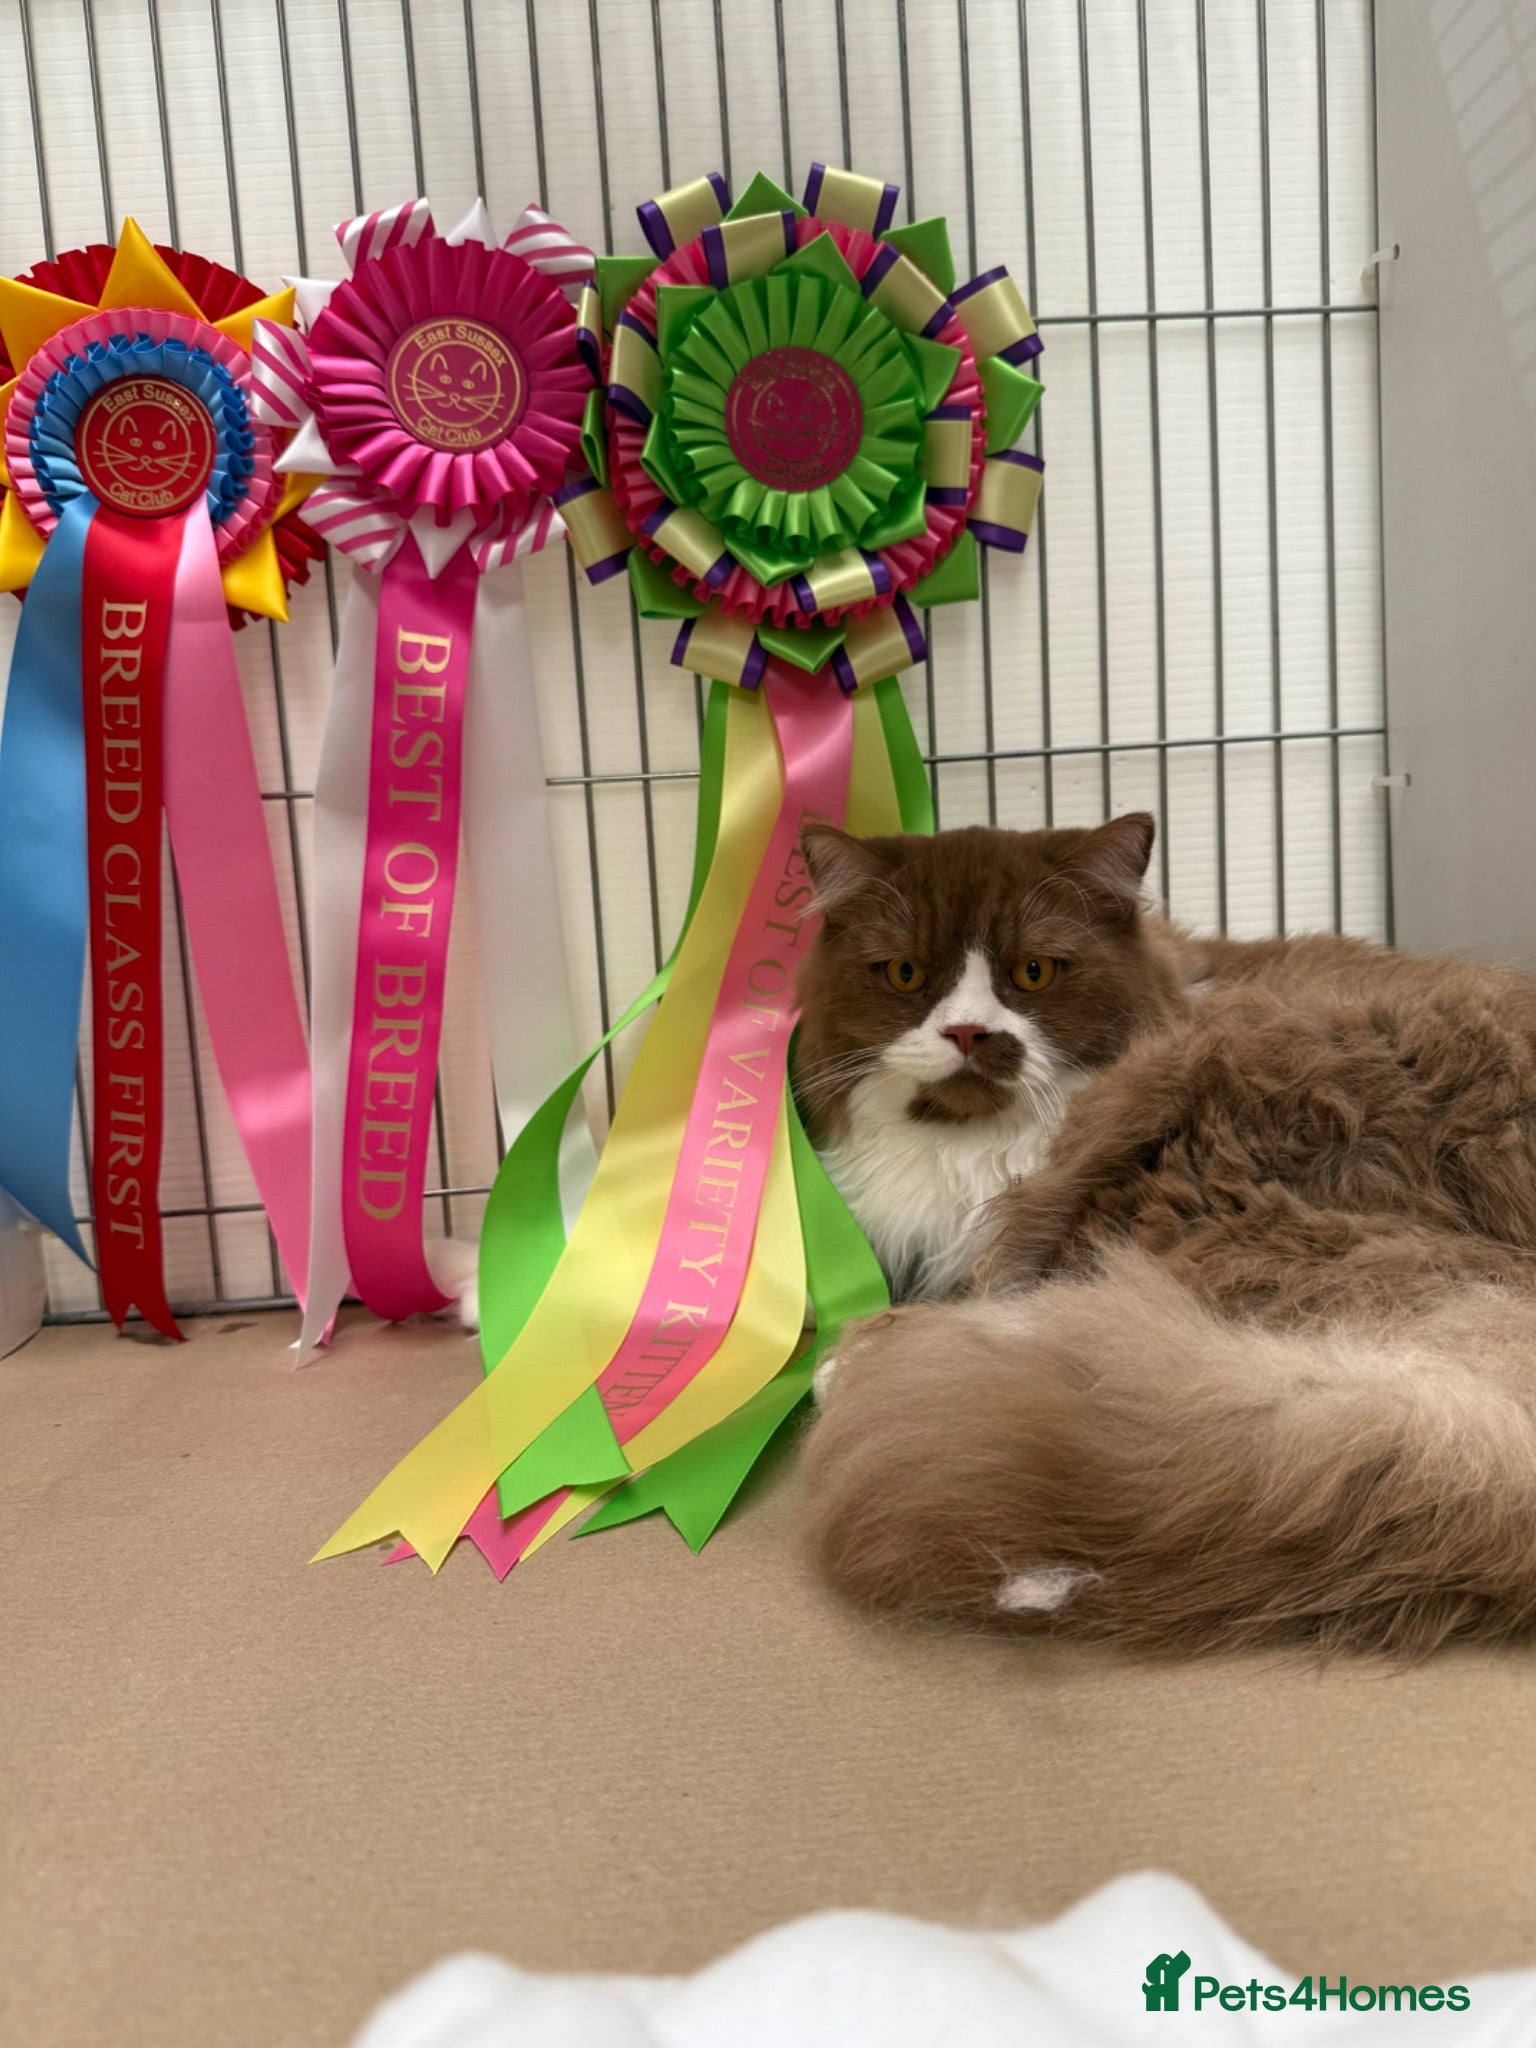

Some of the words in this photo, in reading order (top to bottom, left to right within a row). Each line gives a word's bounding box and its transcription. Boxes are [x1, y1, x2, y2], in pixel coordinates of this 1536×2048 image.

[102, 386, 138, 414] East
[143, 384, 197, 426] Sussex
[414, 326, 450, 350] East
[455, 325, 507, 368] Sussex
[109, 482, 137, 504] Cat
[137, 488, 174, 506] Club
[417, 416, 444, 440] Cat
[445, 428, 482, 444] Club
[99, 597, 147, 824] BREED
[388, 625, 453, 822] BEST
[102, 843, 145, 1050] CLASS
[380, 842, 440, 938] OF
[741, 958, 788, 1032] OF
[357, 959, 428, 1221] BREED
[107, 1072, 145, 1250] FIRST
[678, 1047, 772, 1288] VARIETY
